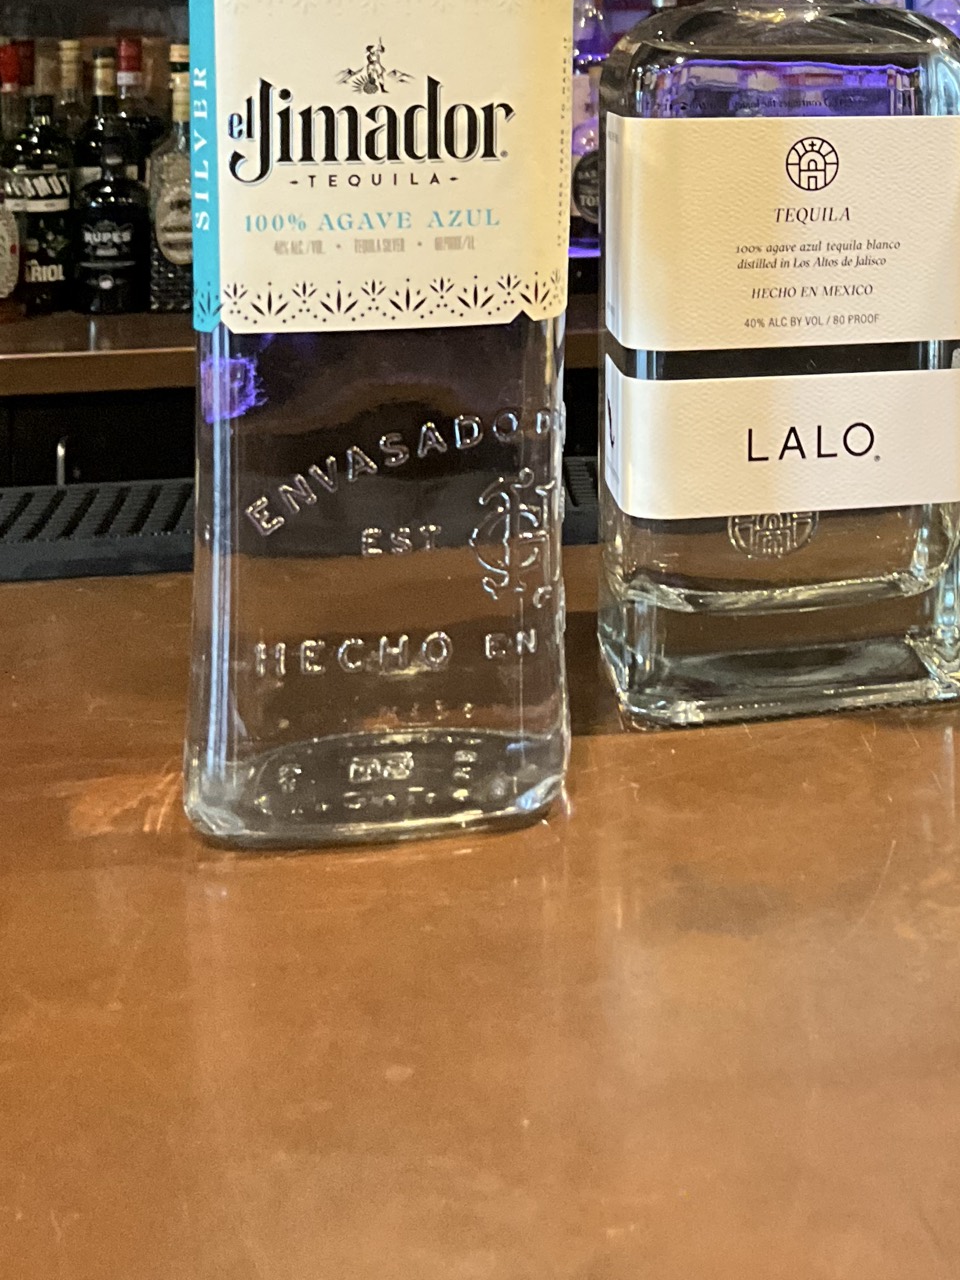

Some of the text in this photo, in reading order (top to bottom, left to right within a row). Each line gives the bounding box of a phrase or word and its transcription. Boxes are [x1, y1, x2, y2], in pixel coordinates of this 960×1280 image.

[193, 67, 209, 232] SILVER
[308, 173, 441, 188] TEQUILA
[245, 208, 501, 233] 100% AGAVE AZUL
[774, 206, 851, 225] TEQUILA
[736, 238, 901, 256] 100% agave azul tequila blanco
[737, 255, 887, 269] distilled in Los Altos de Jalisco
[751, 284, 874, 299] HECHO EN MEXICO
[744, 318, 766, 328] 40%
[768, 317, 787, 328] ALC
[790, 316, 803, 327] BY
[805, 315, 823, 326] VOL
[833, 314, 845, 325] 80
[848, 313, 880, 324] PROOF
[747, 421, 876, 463] LALO
[254, 627, 537, 676] HECHO EN
